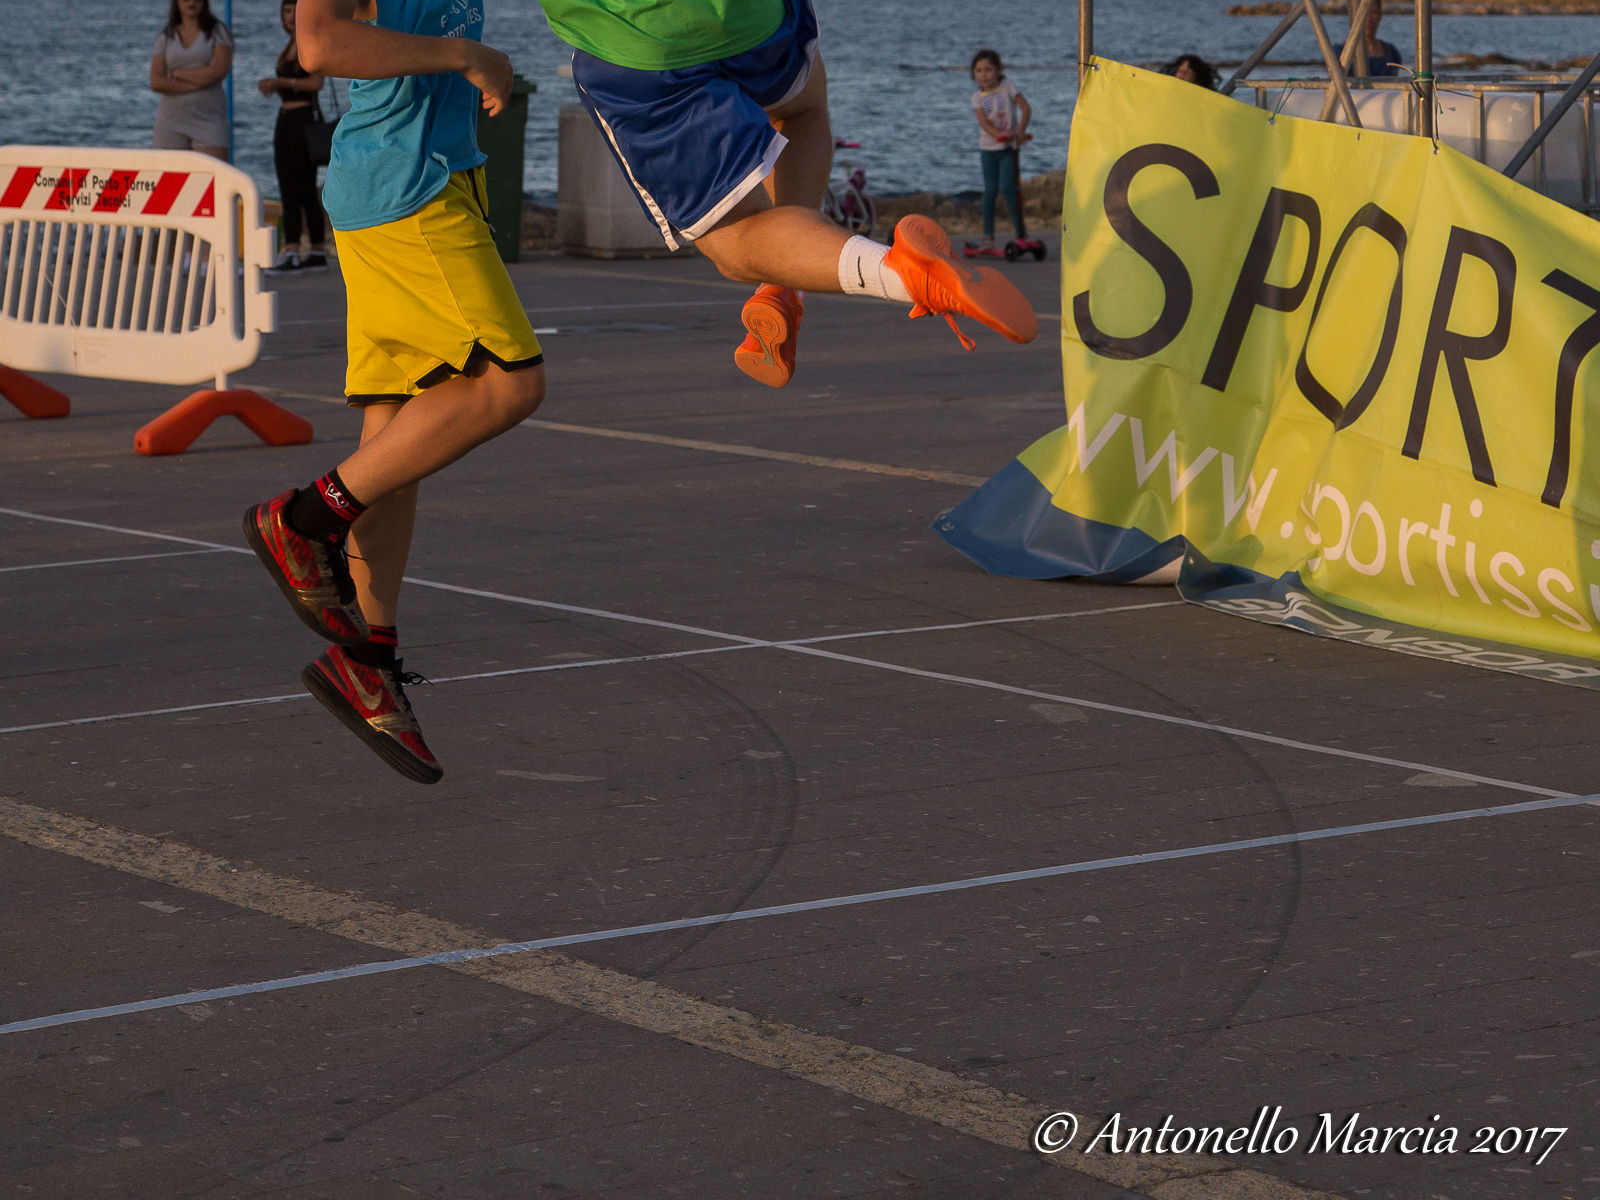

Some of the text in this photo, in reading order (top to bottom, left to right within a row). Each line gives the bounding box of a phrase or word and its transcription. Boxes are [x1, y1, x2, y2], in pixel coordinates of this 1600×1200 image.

[34, 172, 157, 192] Comune di Porto Torres
[59, 190, 132, 208] Servizi Tecnici
